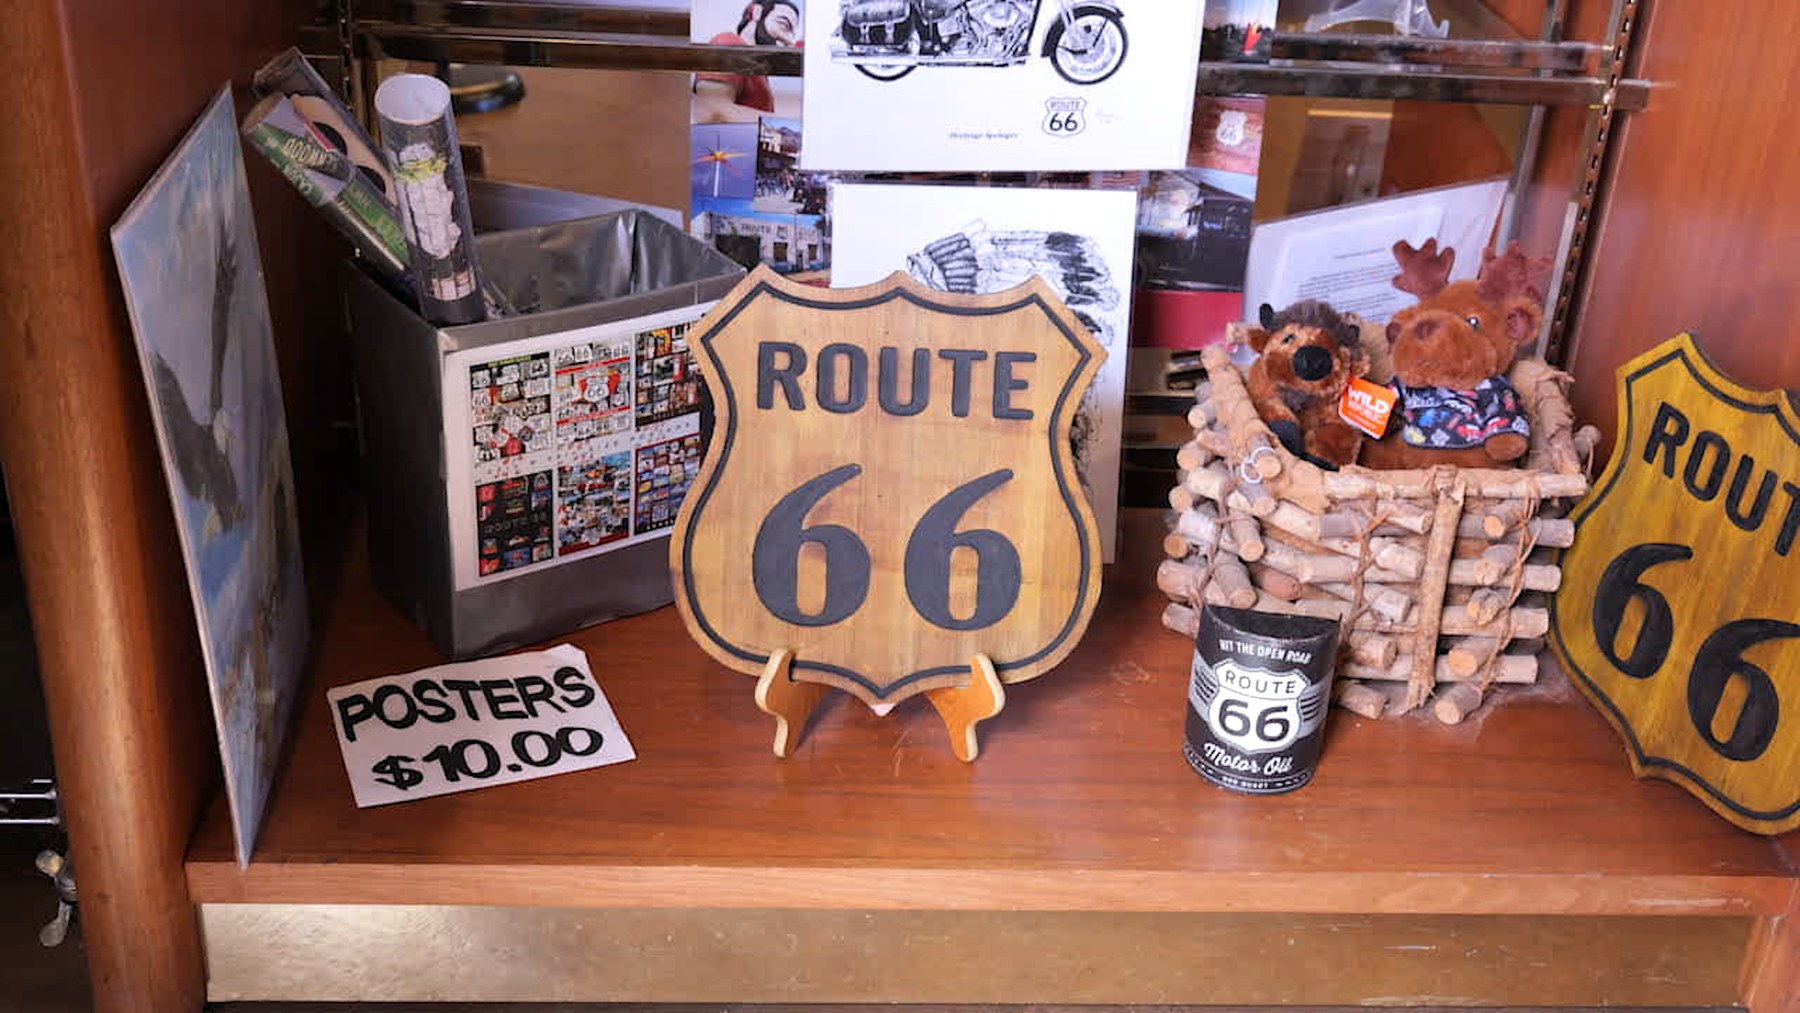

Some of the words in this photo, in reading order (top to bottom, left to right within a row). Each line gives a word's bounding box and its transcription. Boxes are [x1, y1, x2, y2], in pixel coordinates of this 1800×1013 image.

[1049, 112, 1078, 131] 66
[756, 341, 1038, 421] ROUTE
[1348, 386, 1388, 413] WILD
[752, 463, 1022, 631] 66
[1236, 641, 1255, 655] THE
[1257, 645, 1284, 660] OPEN
[1286, 649, 1312, 664] ROAD
[1593, 542, 1800, 761] 66
[337, 666, 595, 742] POSTERS
[1225, 670, 1297, 694] ROUTE
[1218, 698, 1290, 742] 66
[372, 726, 604, 791] $10.00
[1203, 742, 1260, 774] Motor
[1263, 756, 1294, 775] Oil
